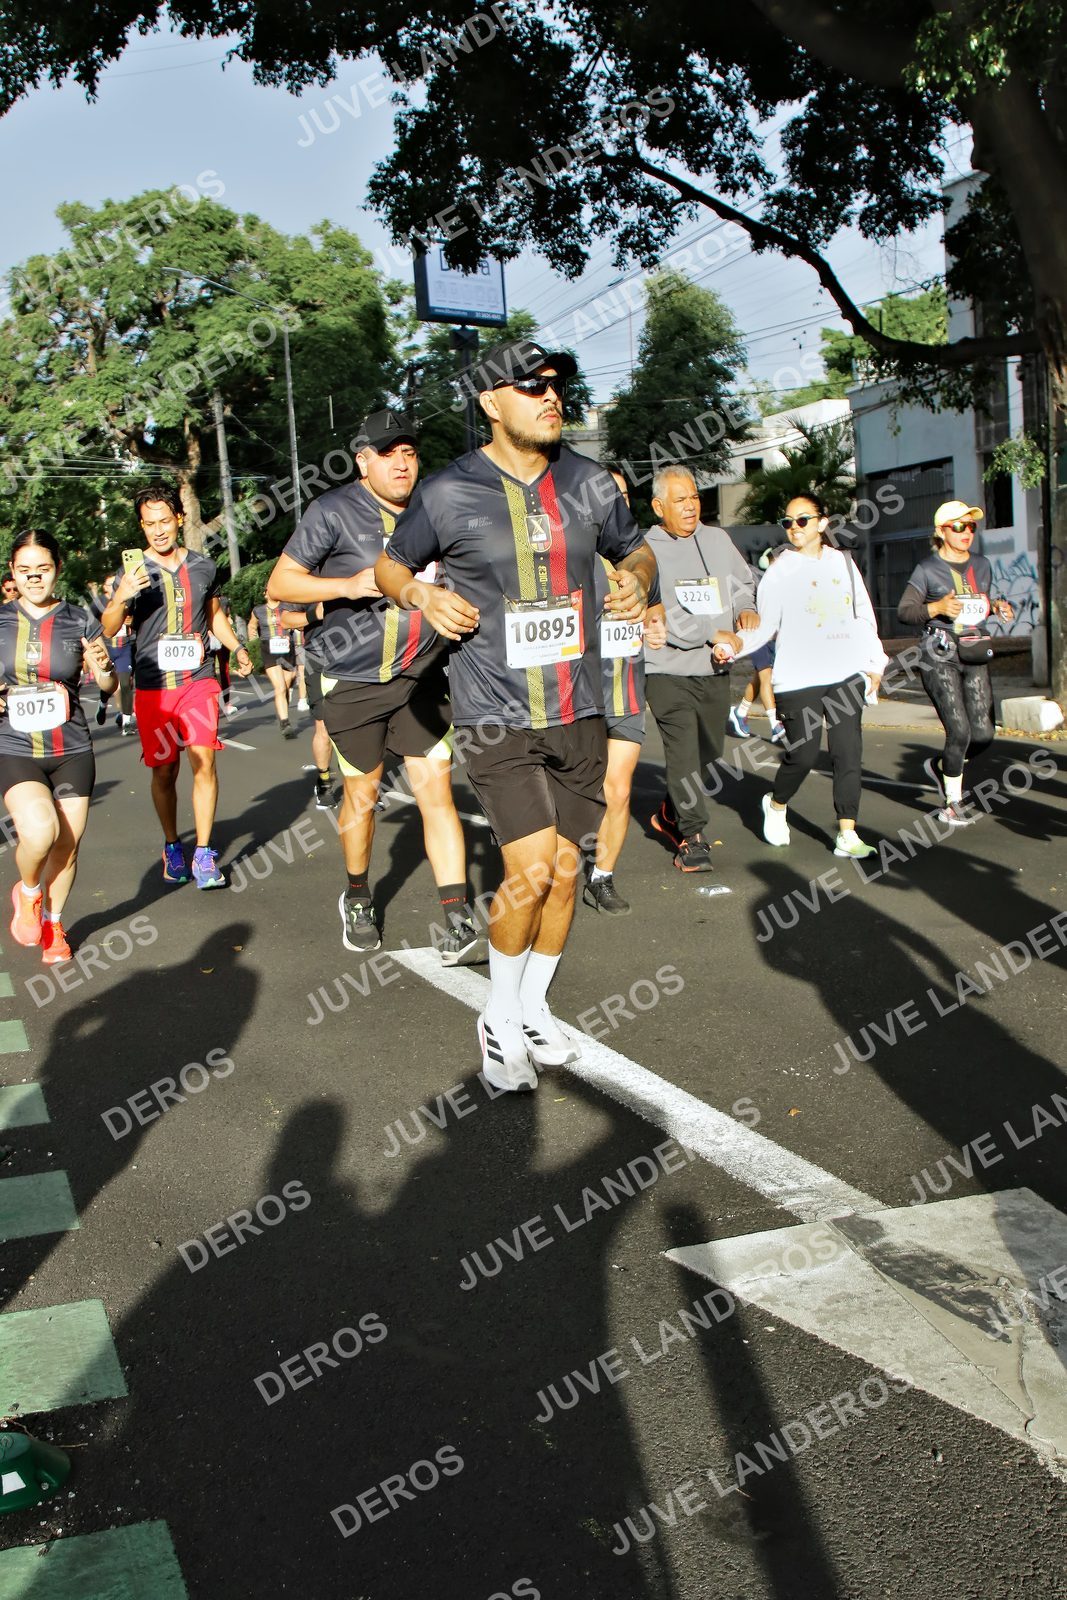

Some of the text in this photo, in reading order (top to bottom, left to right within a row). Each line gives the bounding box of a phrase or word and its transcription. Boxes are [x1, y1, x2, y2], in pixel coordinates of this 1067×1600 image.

[384, 412, 403, 431] A
[682, 591, 711, 602] 3226
[511, 615, 576, 644] 10895
[605, 625, 643, 642] 10294
[164, 645, 195, 658] 8078
[16, 698, 55, 717] 8075
